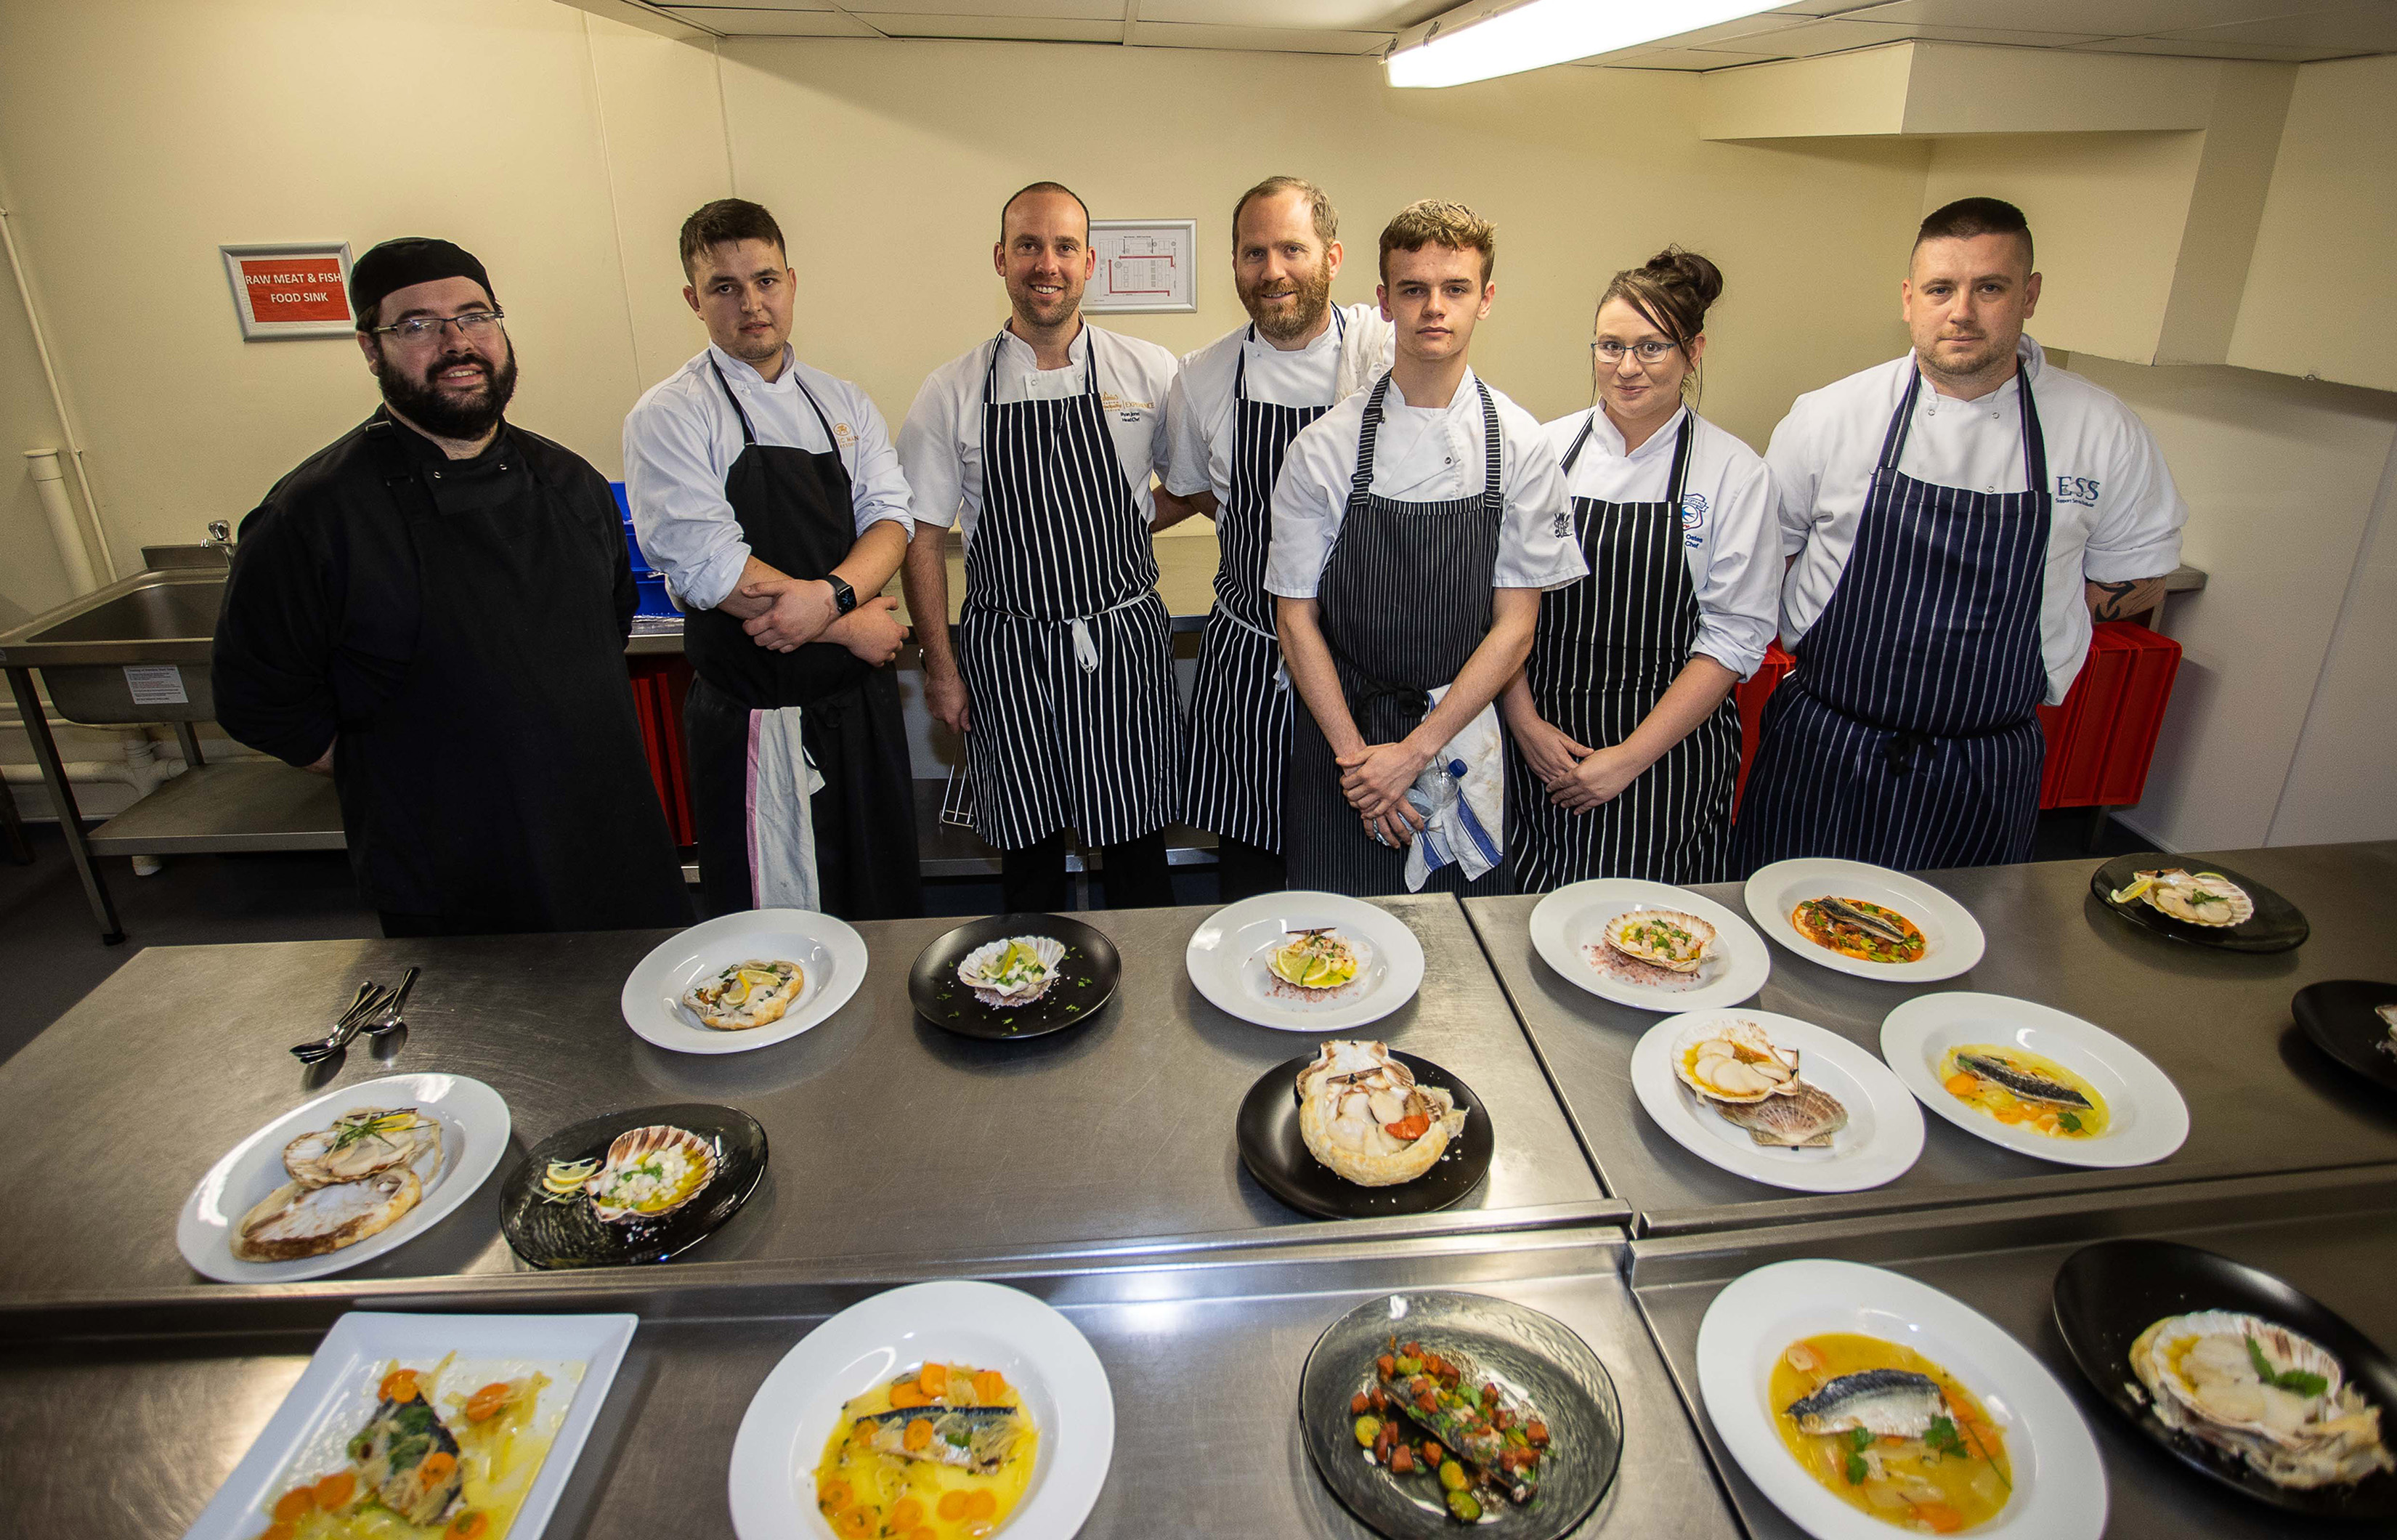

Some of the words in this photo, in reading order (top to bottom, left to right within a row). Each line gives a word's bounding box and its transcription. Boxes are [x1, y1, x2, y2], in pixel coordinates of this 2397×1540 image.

[245, 275, 271, 285] RAW
[273, 273, 304, 284] MEAT
[307, 273, 317, 283] &
[318, 273, 342, 283] FISH
[270, 293, 301, 303] FOOD
[304, 292, 328, 302] SINK
[2056, 476, 2100, 500] ESS
